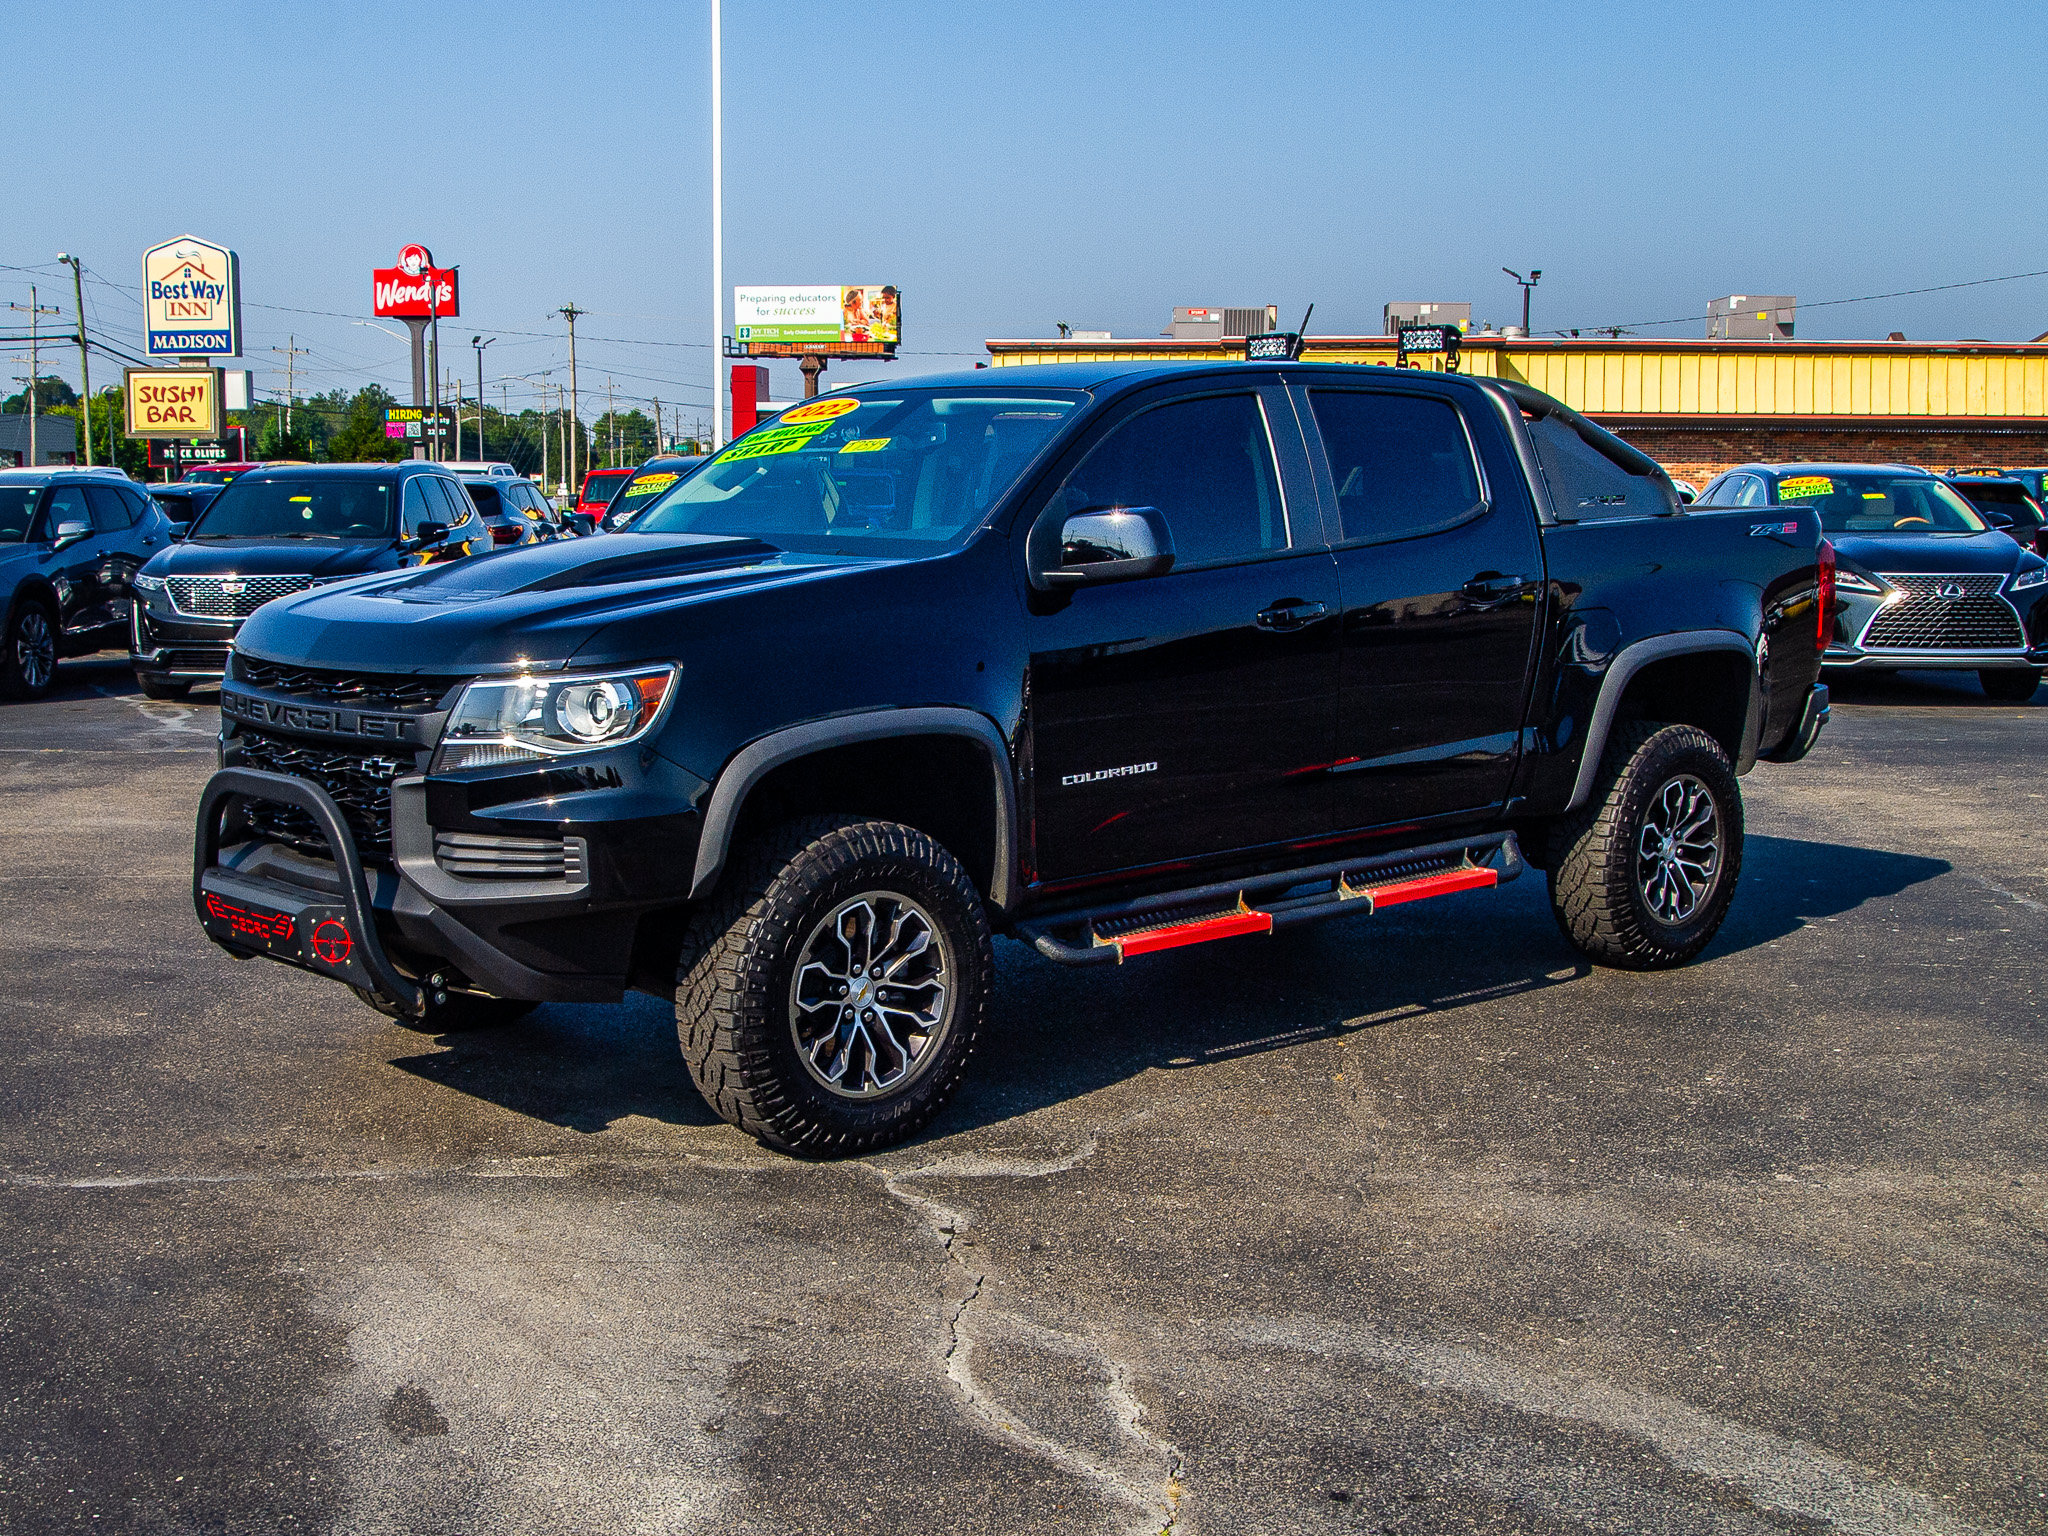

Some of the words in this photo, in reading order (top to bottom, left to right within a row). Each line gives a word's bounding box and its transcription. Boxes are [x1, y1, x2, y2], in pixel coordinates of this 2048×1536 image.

[151, 281, 189, 300] Best
[190, 280, 225, 305] Way
[376, 275, 453, 310] Wendy's
[740, 294, 787, 305] Preparing
[789, 293, 837, 302] educators
[169, 301, 208, 316] INN
[756, 307, 771, 316] for
[773, 307, 816, 316] success
[153, 334, 228, 349] MADISON
[139, 386, 204, 403] SUSHI
[146, 406, 197, 423] BAR
[388, 409, 423, 420] HIRING
[783, 402, 856, 420] 2022
[386, 426, 405, 438] PAY
[163, 449, 192, 459] BLCK
[194, 449, 226, 459] OLIVES
[724, 439, 799, 461] SHARP
[1786, 478, 1825, 486] 2022
[1781, 488, 1832, 499] LEATHER
[222, 691, 417, 740] CHEVROLET
[1062, 761, 1158, 786] COLORADO
